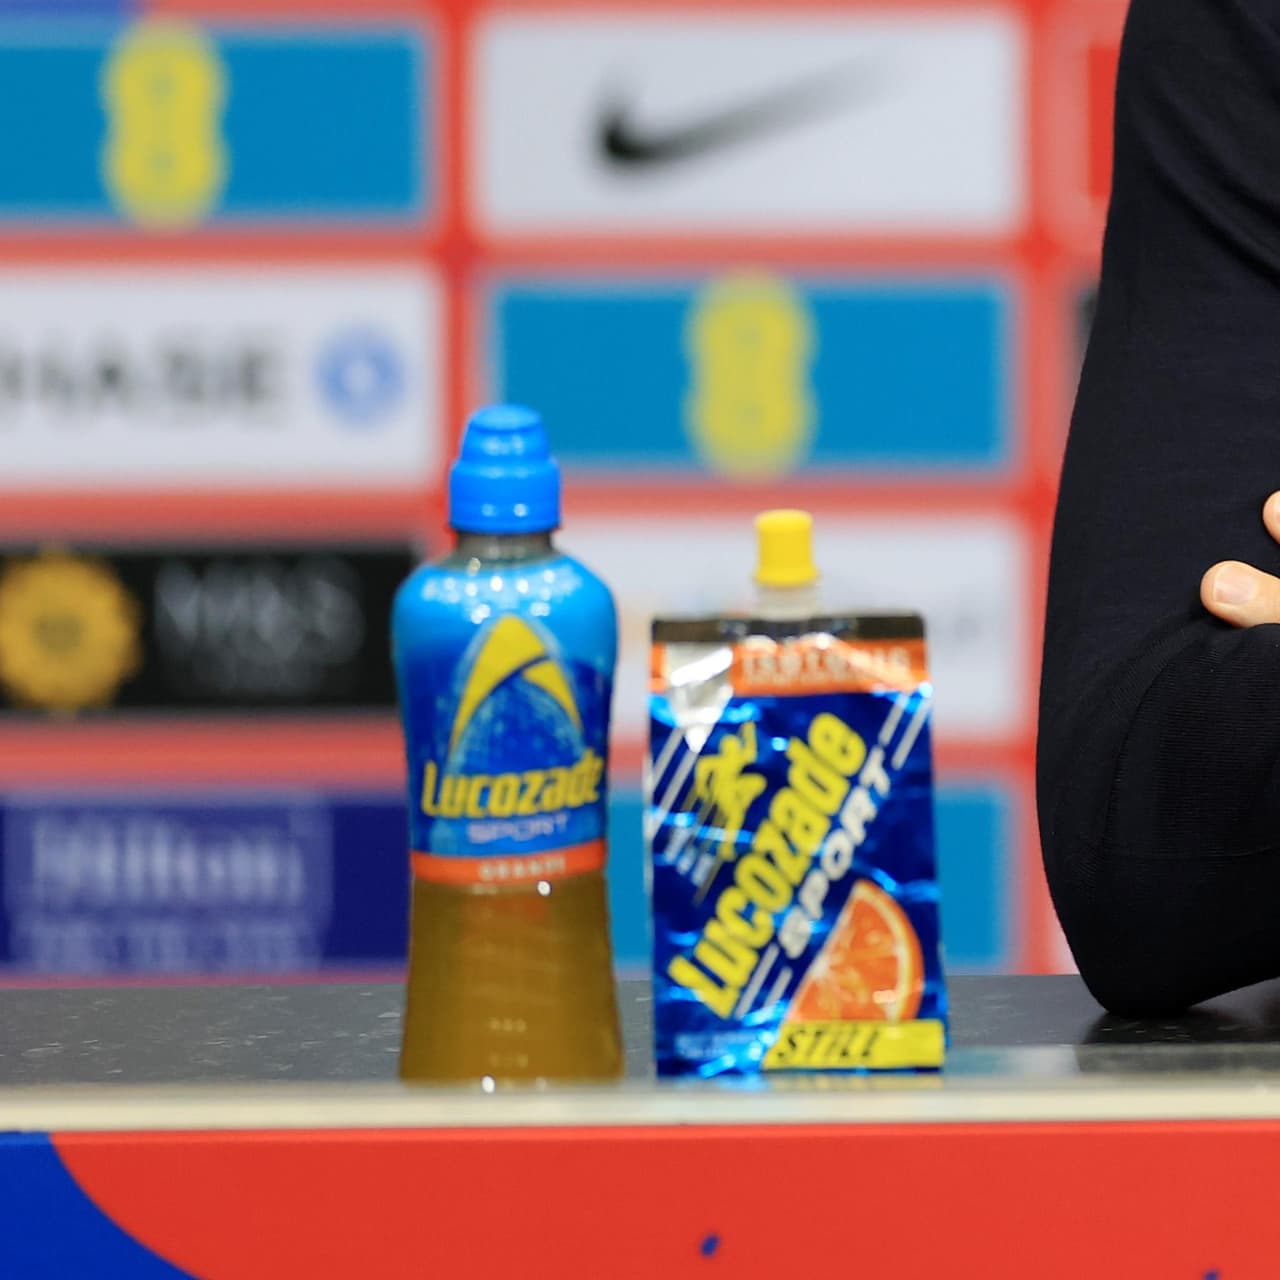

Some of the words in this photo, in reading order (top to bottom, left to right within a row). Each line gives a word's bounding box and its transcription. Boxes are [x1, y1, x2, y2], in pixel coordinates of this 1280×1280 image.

[421, 749, 604, 817] Lucozade
[778, 745, 890, 959] SPORT
[668, 713, 866, 1019] Lucozade
[775, 1029, 880, 1060] STILL
